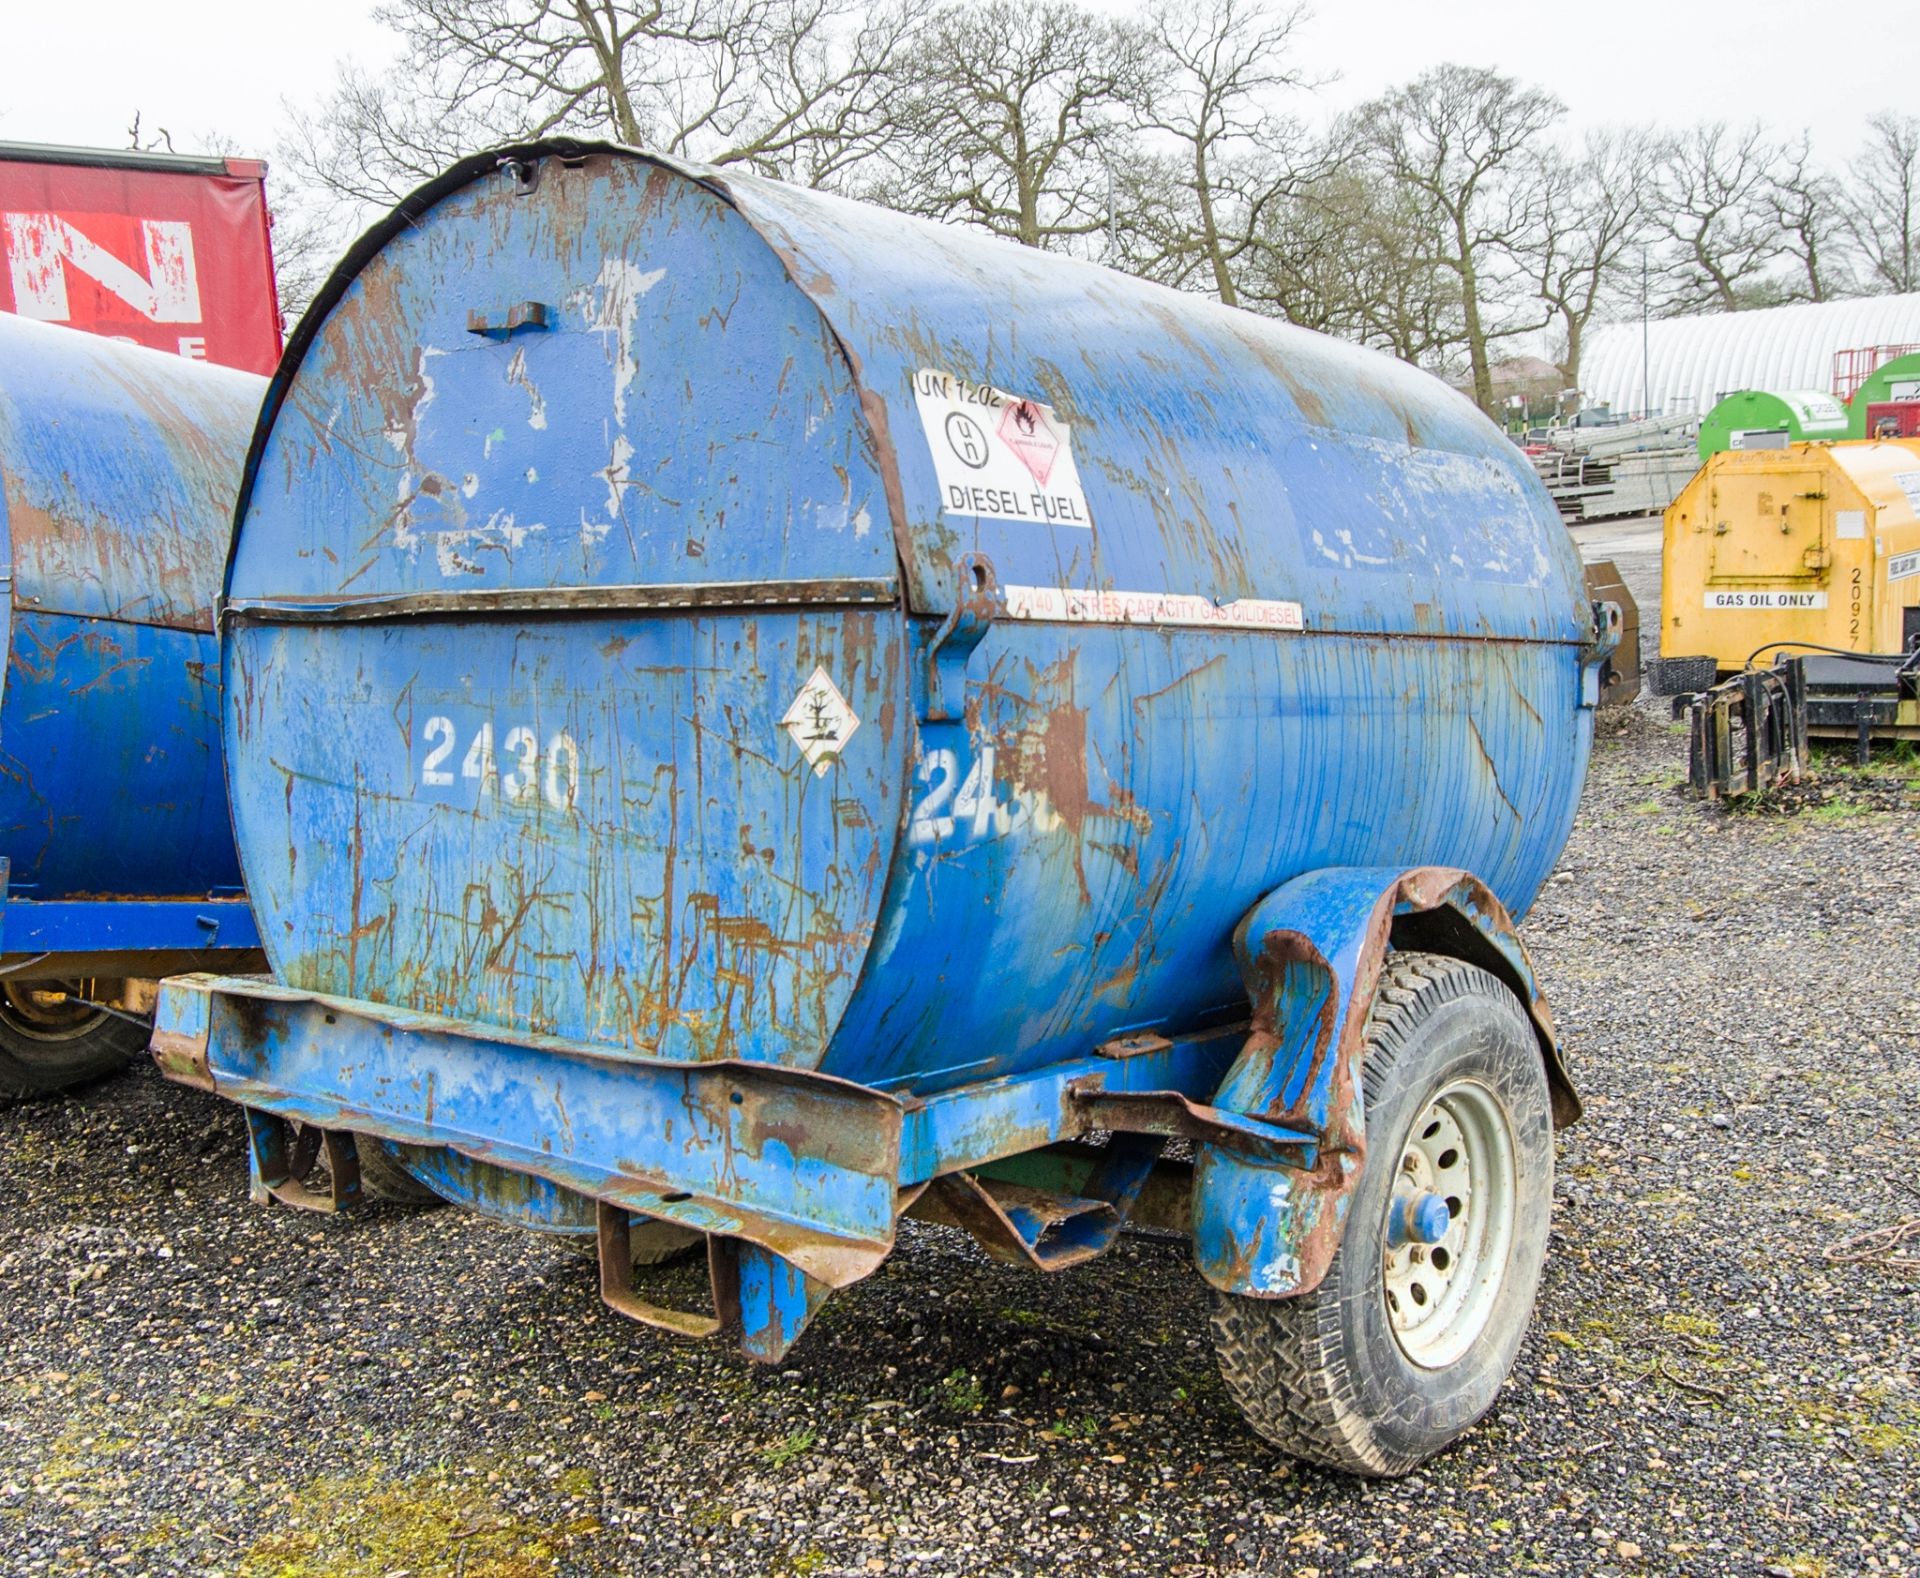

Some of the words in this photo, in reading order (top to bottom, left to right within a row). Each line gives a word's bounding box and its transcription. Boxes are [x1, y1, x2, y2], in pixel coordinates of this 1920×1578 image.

[916, 372, 948, 399] UN
[949, 485, 1027, 516] DIESEL
[1031, 493, 1083, 521] FUEL
[1126, 598, 1196, 618] CAPACITY
[1716, 594, 1744, 606] GAS
[1749, 594, 1773, 606] OIL
[1778, 594, 1816, 606] ONLY
[1850, 567, 1862, 649] 20927
[422, 716, 580, 812] 2430
